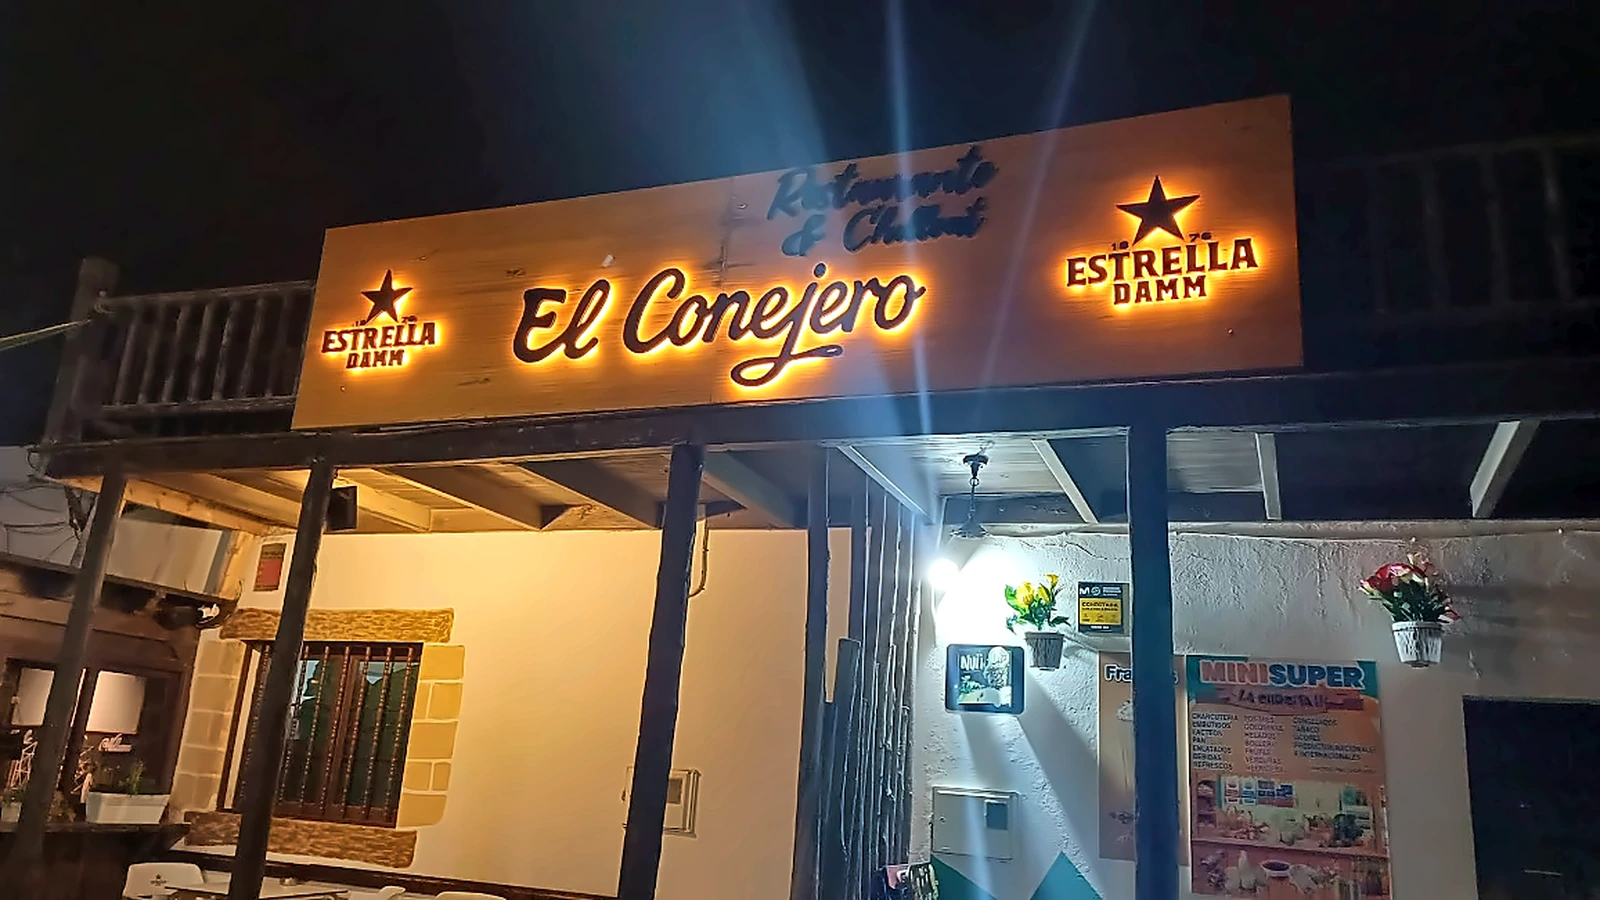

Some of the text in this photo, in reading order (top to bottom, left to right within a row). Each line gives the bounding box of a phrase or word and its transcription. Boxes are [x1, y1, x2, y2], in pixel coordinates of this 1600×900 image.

[1066, 237, 1259, 287] ESTRELLA
[1113, 275, 1207, 305] DAMM
[321, 322, 436, 354] ESTRELLA
[512, 262, 926, 387] El Conejero
[346, 349, 404, 369] DAMM
